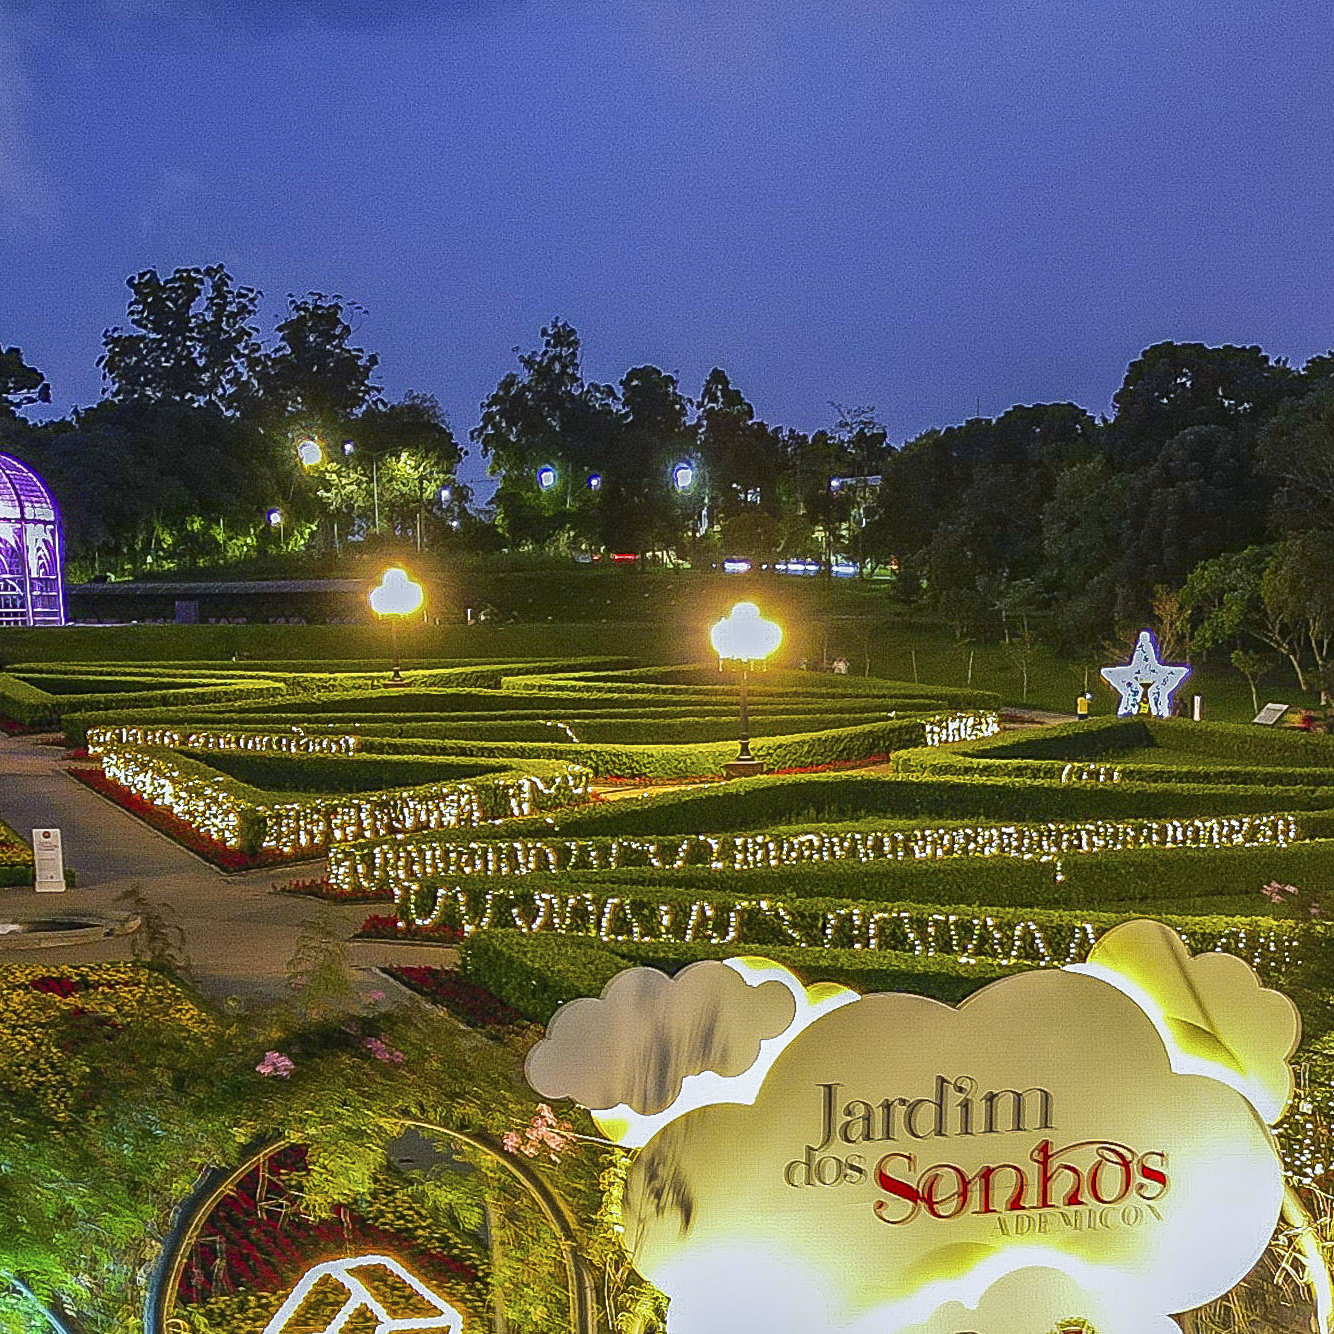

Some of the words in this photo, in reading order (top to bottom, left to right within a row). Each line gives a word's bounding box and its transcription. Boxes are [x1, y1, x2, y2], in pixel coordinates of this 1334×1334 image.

[814, 1074, 1057, 1151] Jardim
[784, 1144, 867, 1188] dos
[873, 1139, 1170, 1225] Sonhos
[994, 1203, 1164, 1237] ADEMICON
